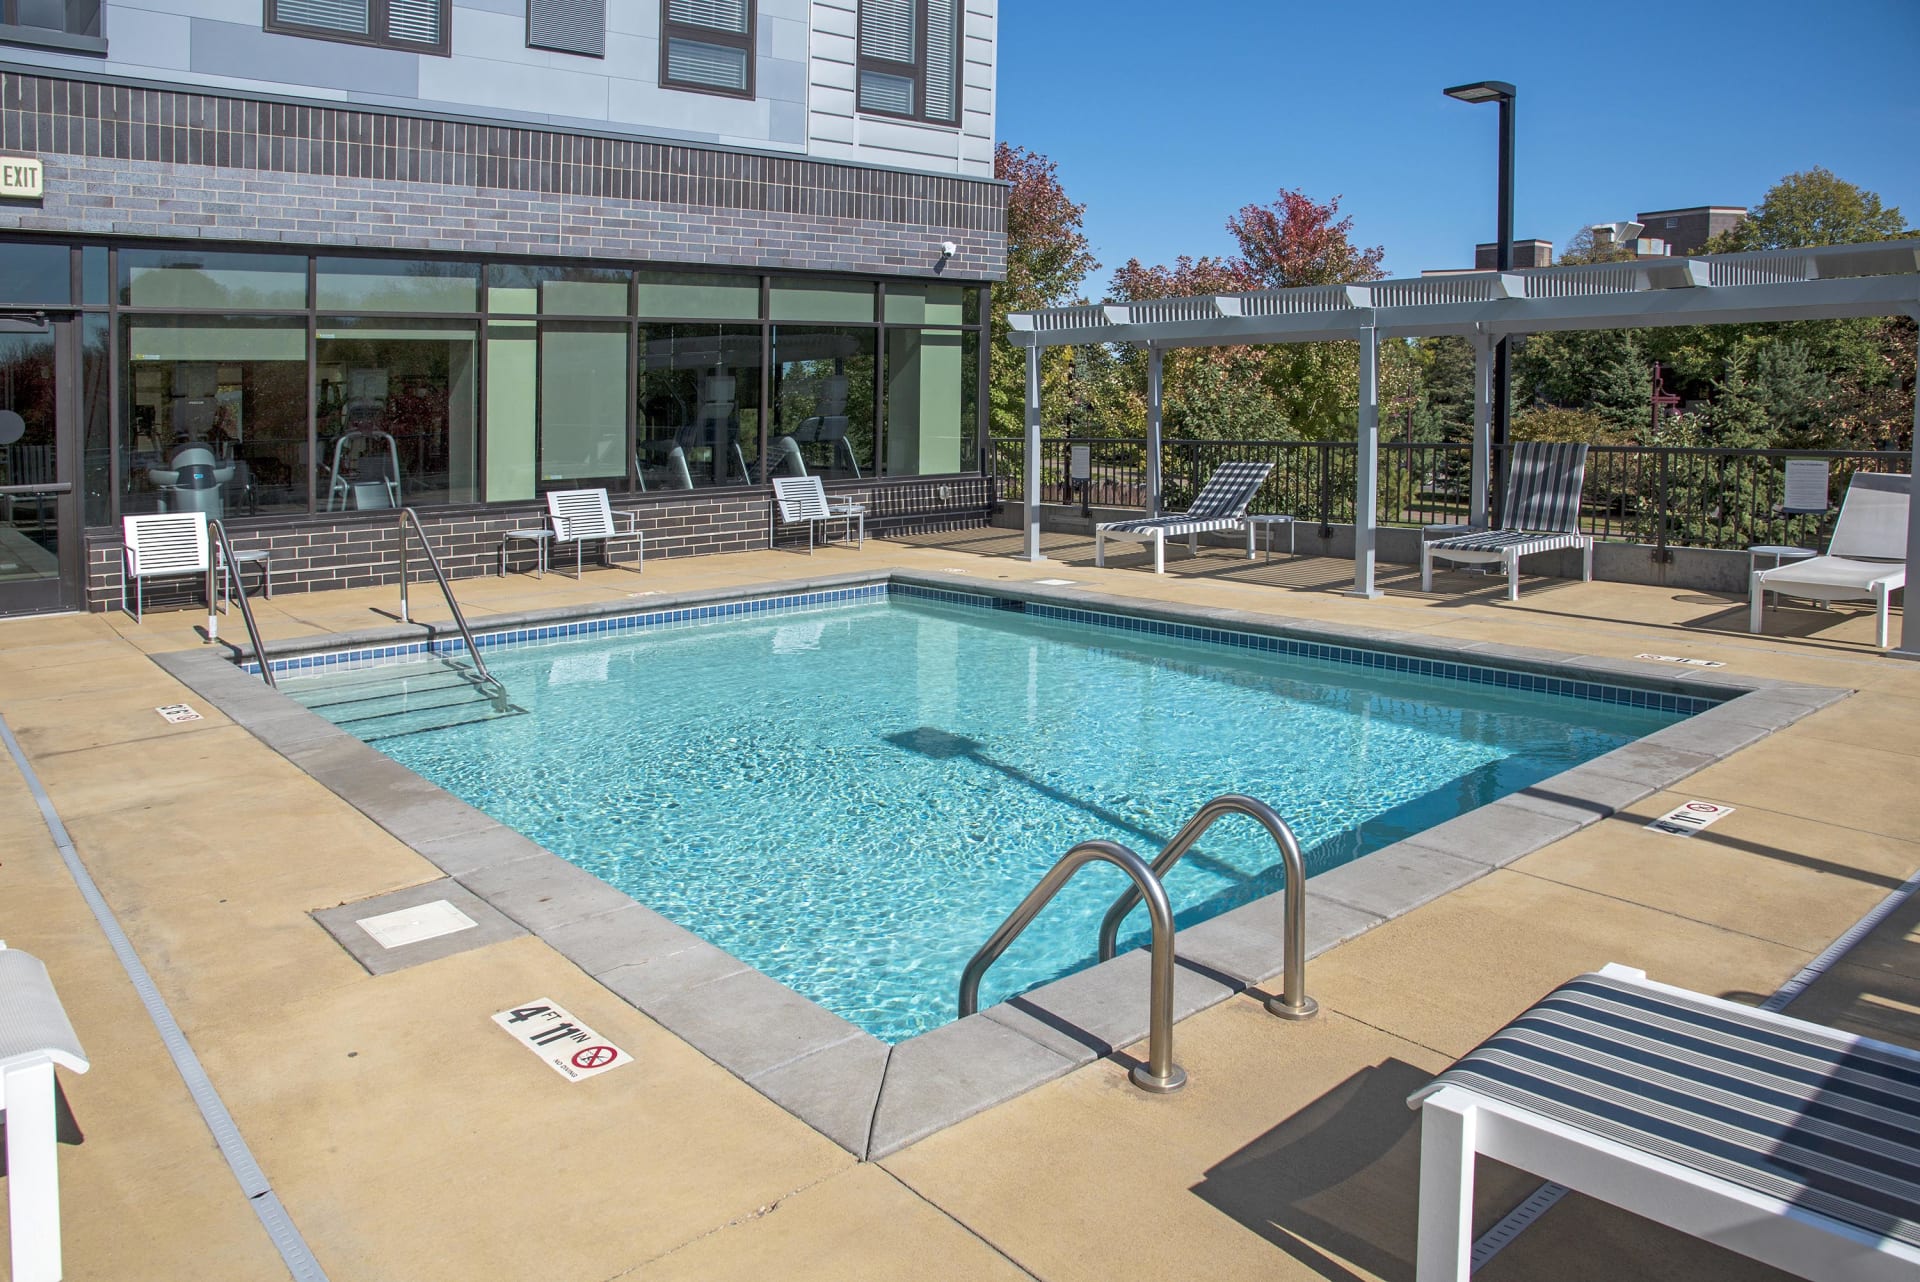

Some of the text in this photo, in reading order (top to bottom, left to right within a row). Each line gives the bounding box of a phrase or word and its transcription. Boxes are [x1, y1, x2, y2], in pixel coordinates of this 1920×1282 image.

[4, 165, 38, 188] EXIT
[1655, 823, 1689, 834] 4
[1669, 814, 1707, 825] 11
[508, 1006, 591, 1047] 4 FT 11 IN
[553, 1058, 578, 1079] NO DIVING
